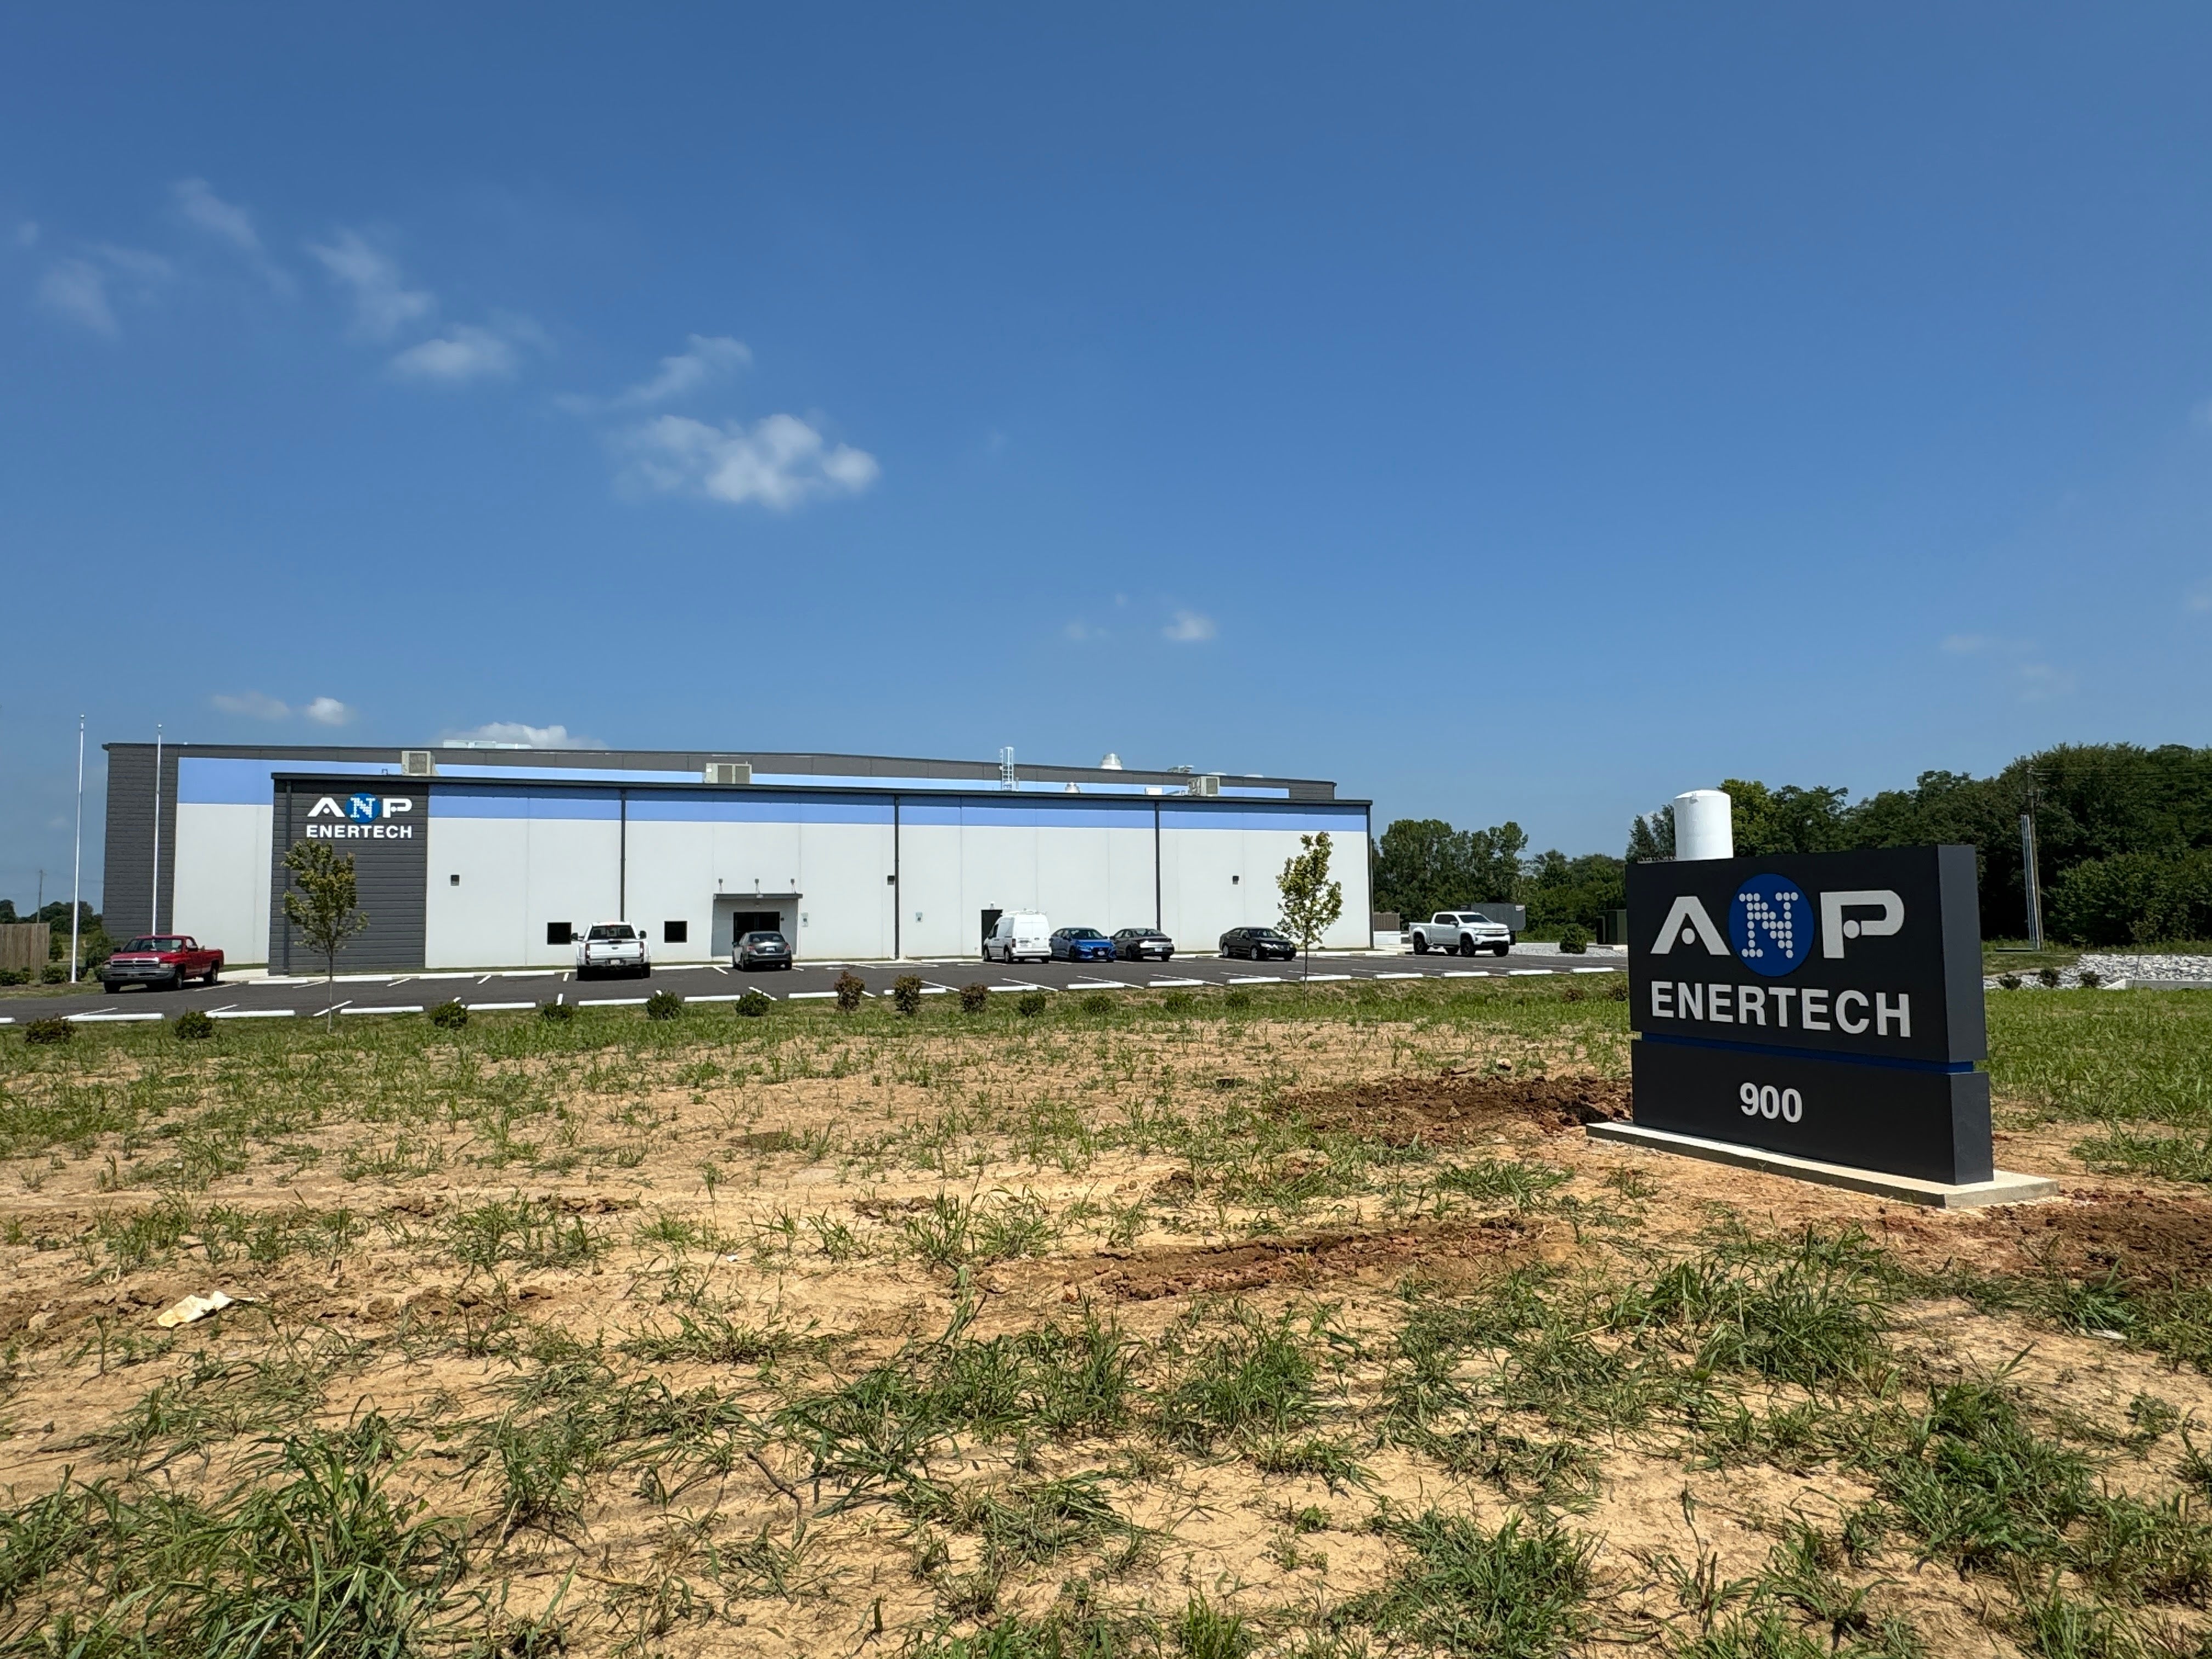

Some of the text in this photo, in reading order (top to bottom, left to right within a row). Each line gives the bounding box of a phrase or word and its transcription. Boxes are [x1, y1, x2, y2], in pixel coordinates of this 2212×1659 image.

[307, 797, 413, 819] ANP
[306, 824, 412, 838] ENERTECH
[1650, 890, 1905, 958] ANP
[1651, 981, 1911, 1037] ENERTECH
[1740, 1082, 1803, 1122] 900
